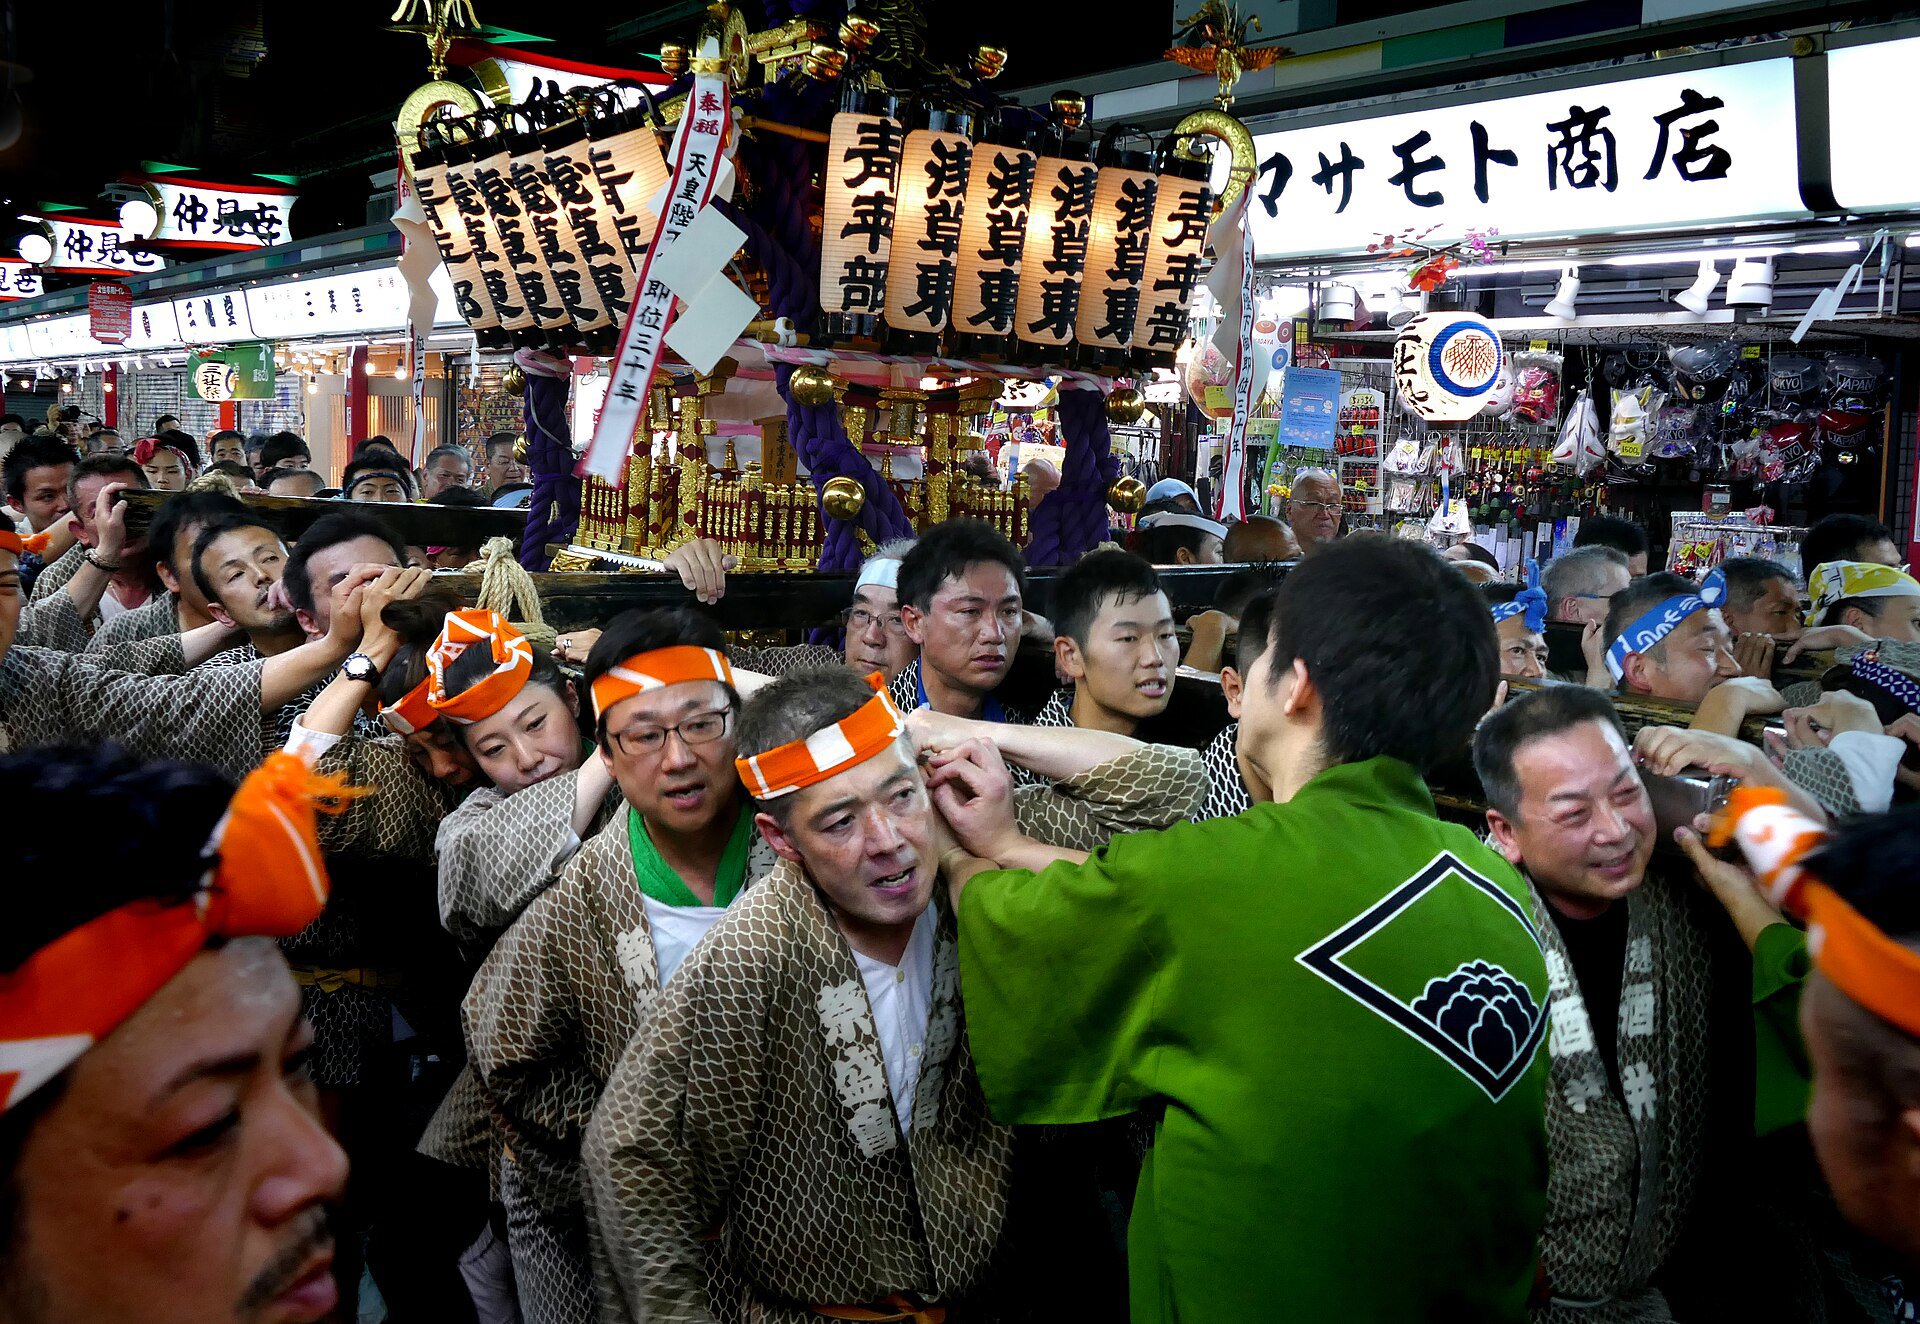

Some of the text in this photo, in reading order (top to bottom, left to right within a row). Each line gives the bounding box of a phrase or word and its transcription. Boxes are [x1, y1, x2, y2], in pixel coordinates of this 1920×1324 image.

[173, 193, 282, 246] 仲見世
[840, 118, 901, 313] 青年部
[903, 137, 973, 328] 浅草東
[1258, 89, 1732, 217] マサモト商店
[614, 91, 722, 402] 奉祝 天皇陛即位三十年
[965, 150, 1036, 331] 浅草東
[1028, 165, 1098, 340] 浅草東
[1094, 177, 1158, 345] 浅草東
[1147, 188, 1214, 347] 青年部
[1830, 433, 1865, 446] JAPAN
[1838, 378, 1873, 392] JAPAN
